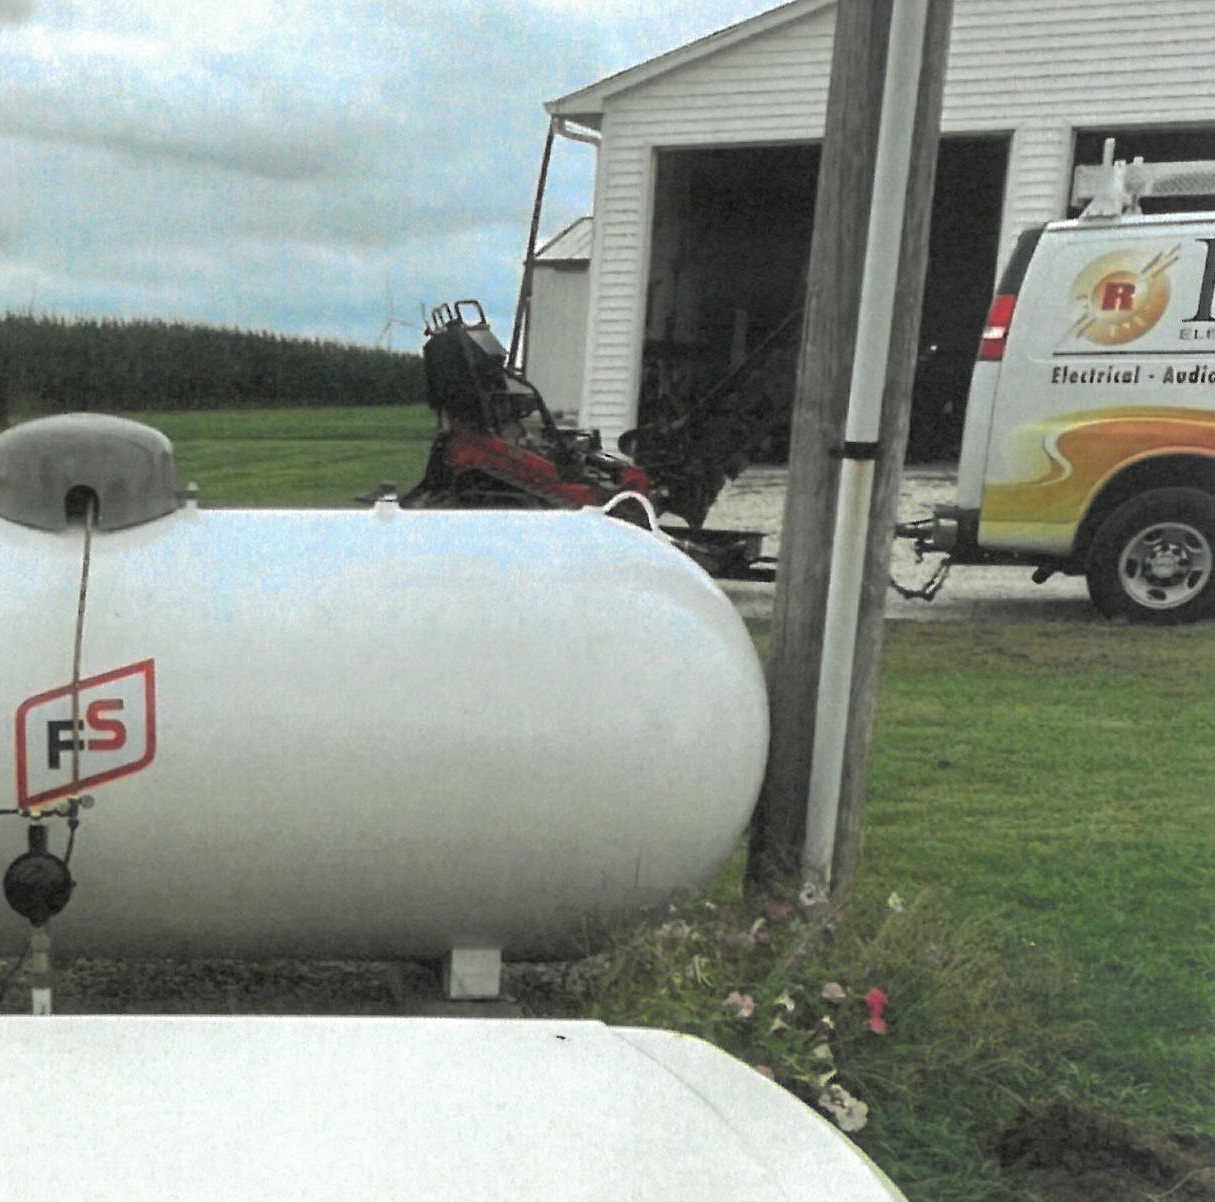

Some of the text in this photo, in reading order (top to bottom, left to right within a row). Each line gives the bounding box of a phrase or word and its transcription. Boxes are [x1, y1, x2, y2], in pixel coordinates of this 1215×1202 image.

[1103, 282, 1136, 310] R
[1052, 366, 1140, 384] Electrical
[47, 698, 127, 770] FS
